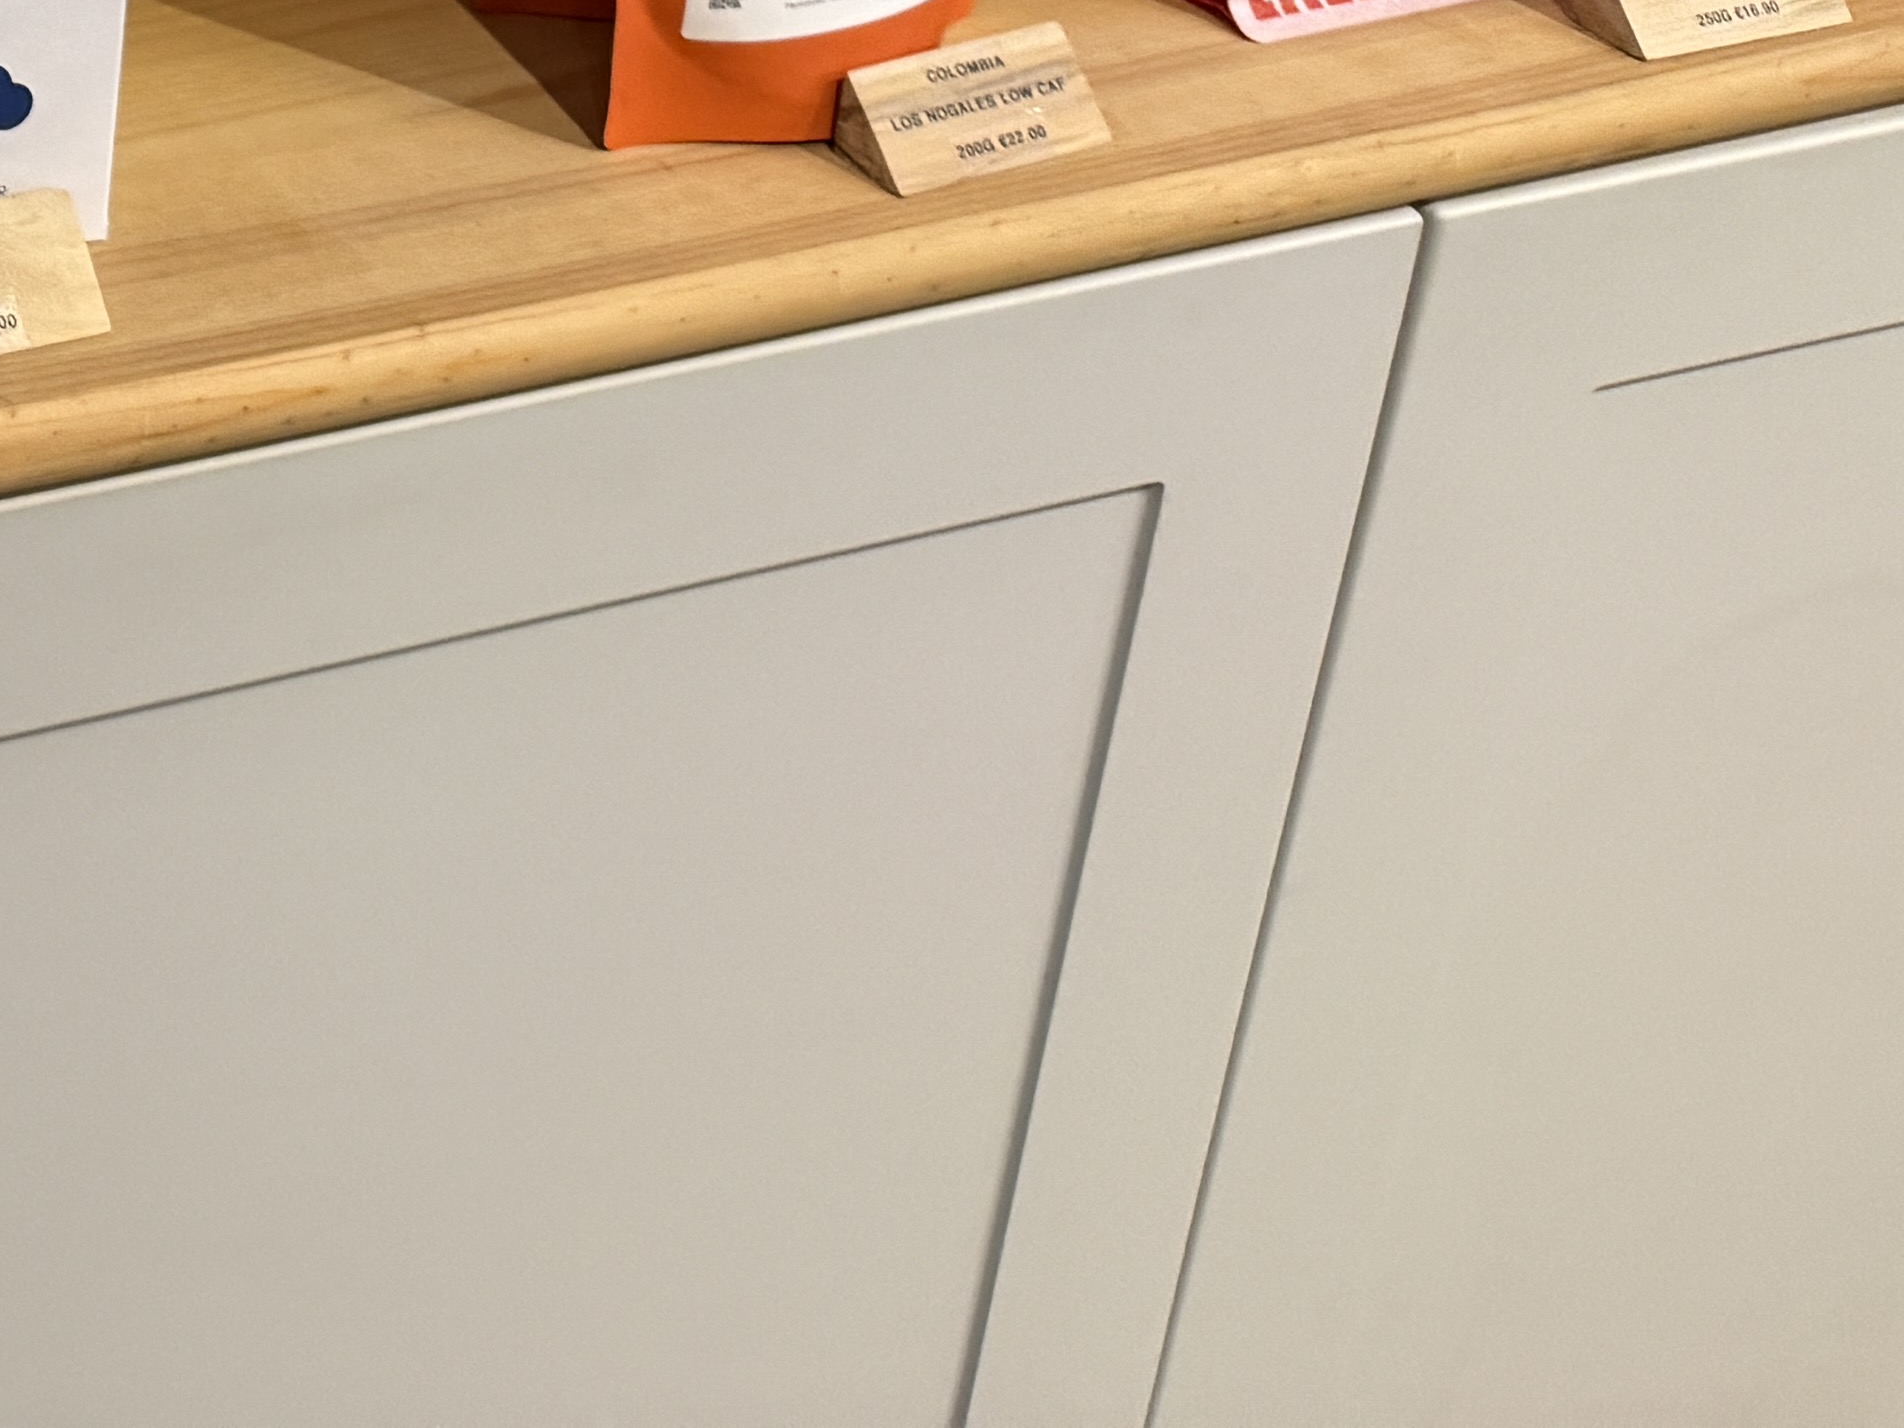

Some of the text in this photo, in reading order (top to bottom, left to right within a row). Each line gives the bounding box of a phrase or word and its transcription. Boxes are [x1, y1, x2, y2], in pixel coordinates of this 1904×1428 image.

[927, 55, 1005, 84] COLOMBIA
[890, 76, 1066, 132] LOS NOGALES LOW CAF
